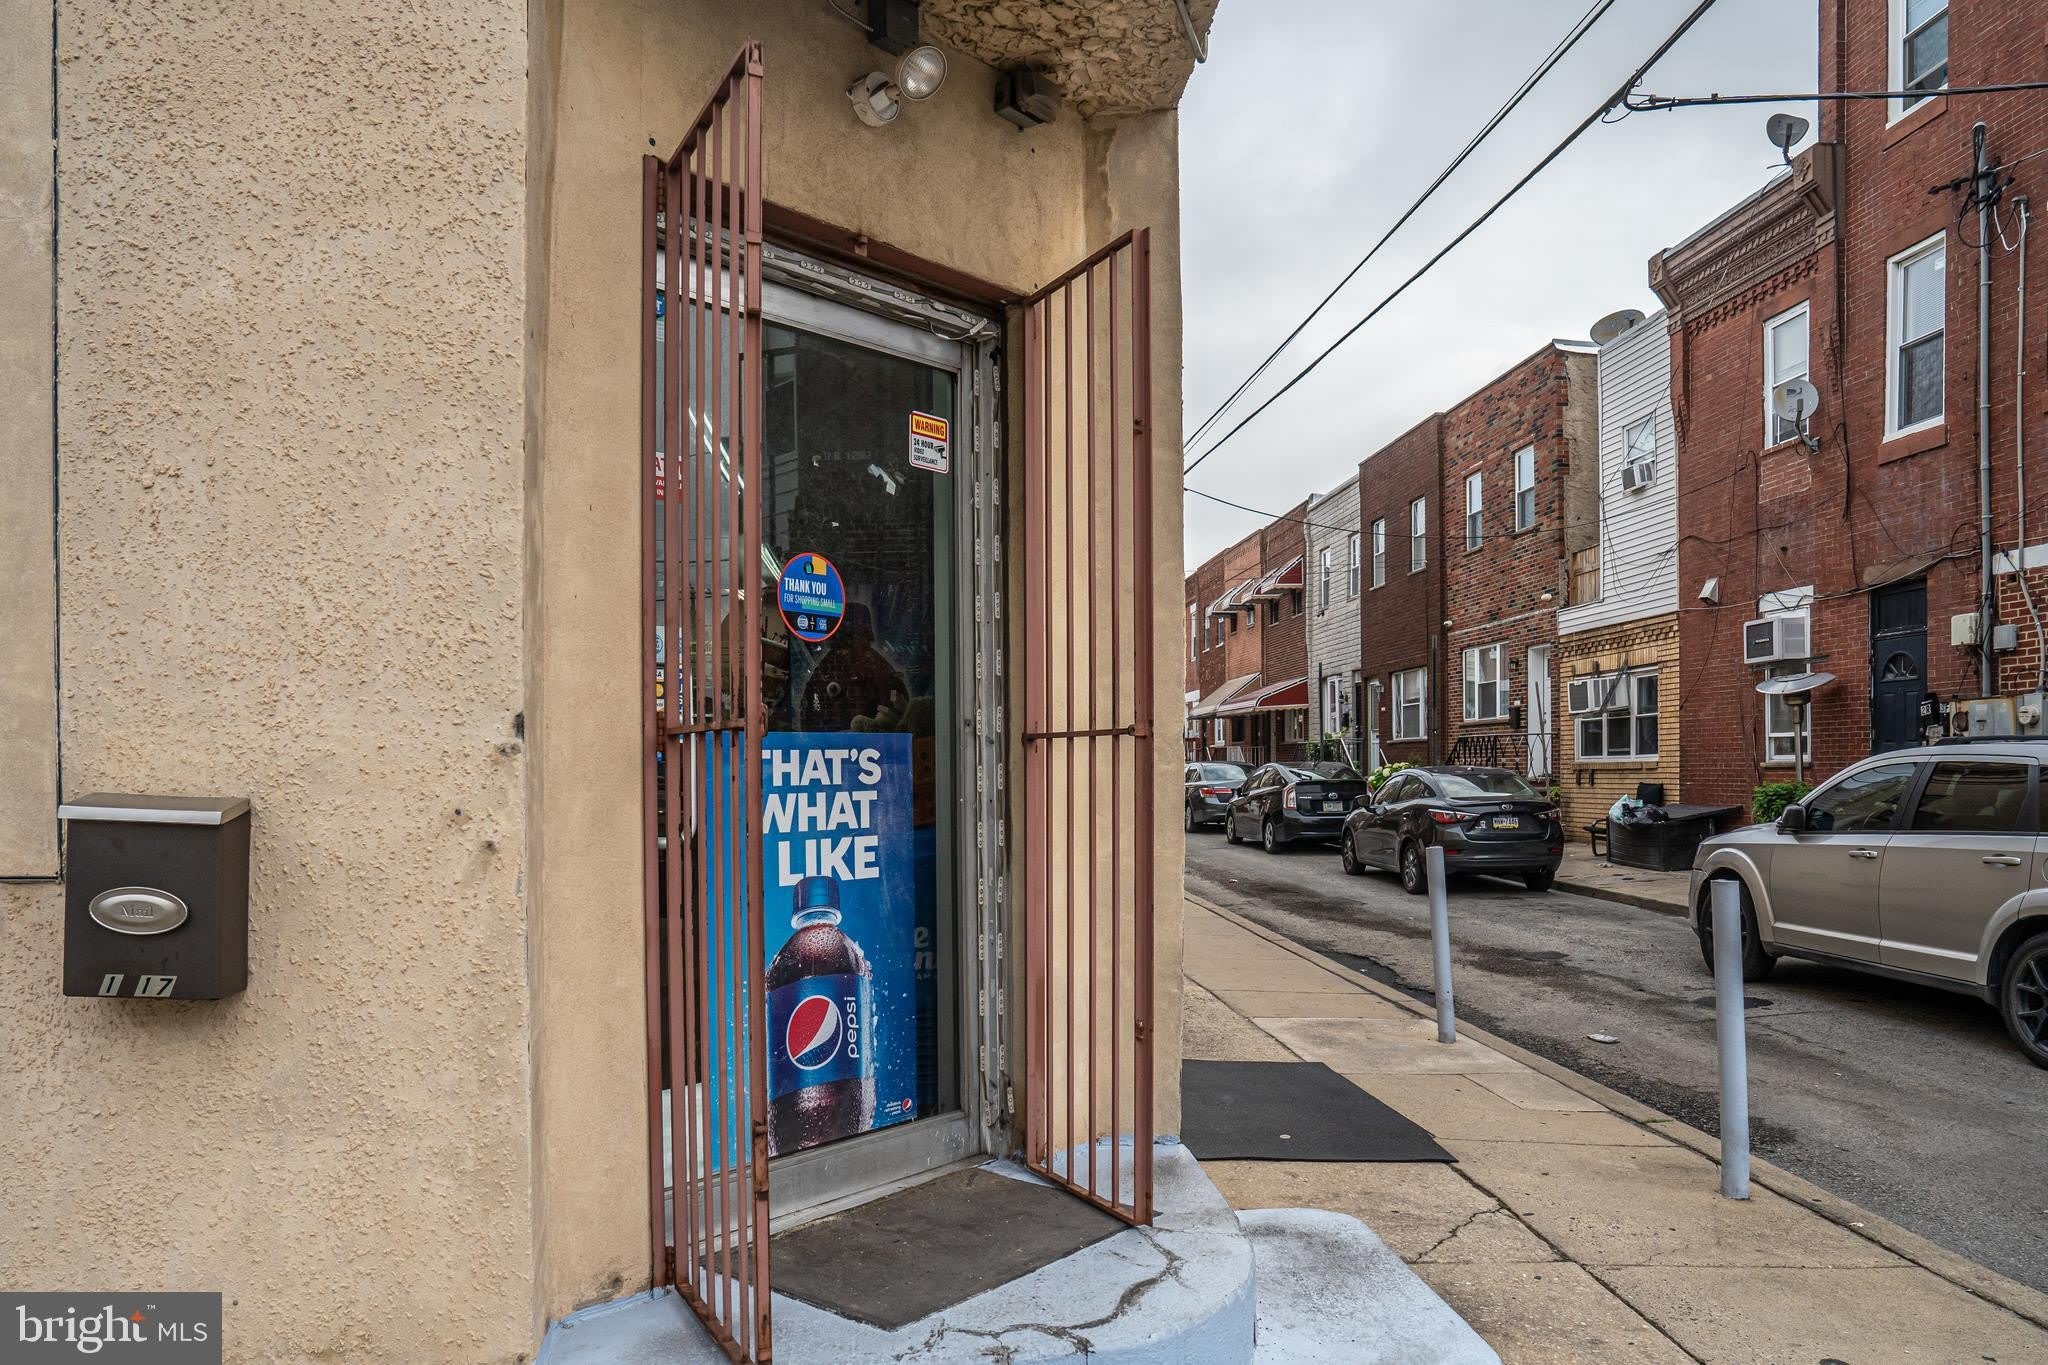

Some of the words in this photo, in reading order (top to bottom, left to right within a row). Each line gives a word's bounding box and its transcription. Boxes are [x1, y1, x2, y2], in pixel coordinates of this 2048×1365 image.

[914, 418, 945, 437] WARNING
[913, 438, 920, 446] 24
[921, 439, 934, 450] HOUR
[914, 446, 925, 455] VIDEO
[913, 454, 938, 466] SURVEILLANCE
[783, 577, 810, 594] THANK
[811, 580, 827, 596] YOU
[783, 592, 794, 603] FOR
[794, 594, 819, 607] SHOPPING
[820, 598, 836, 609] SMALL
[762, 790, 878, 834] WHAT
[778, 835, 880, 887] LIKE
[844, 996, 860, 1059] pepsi
